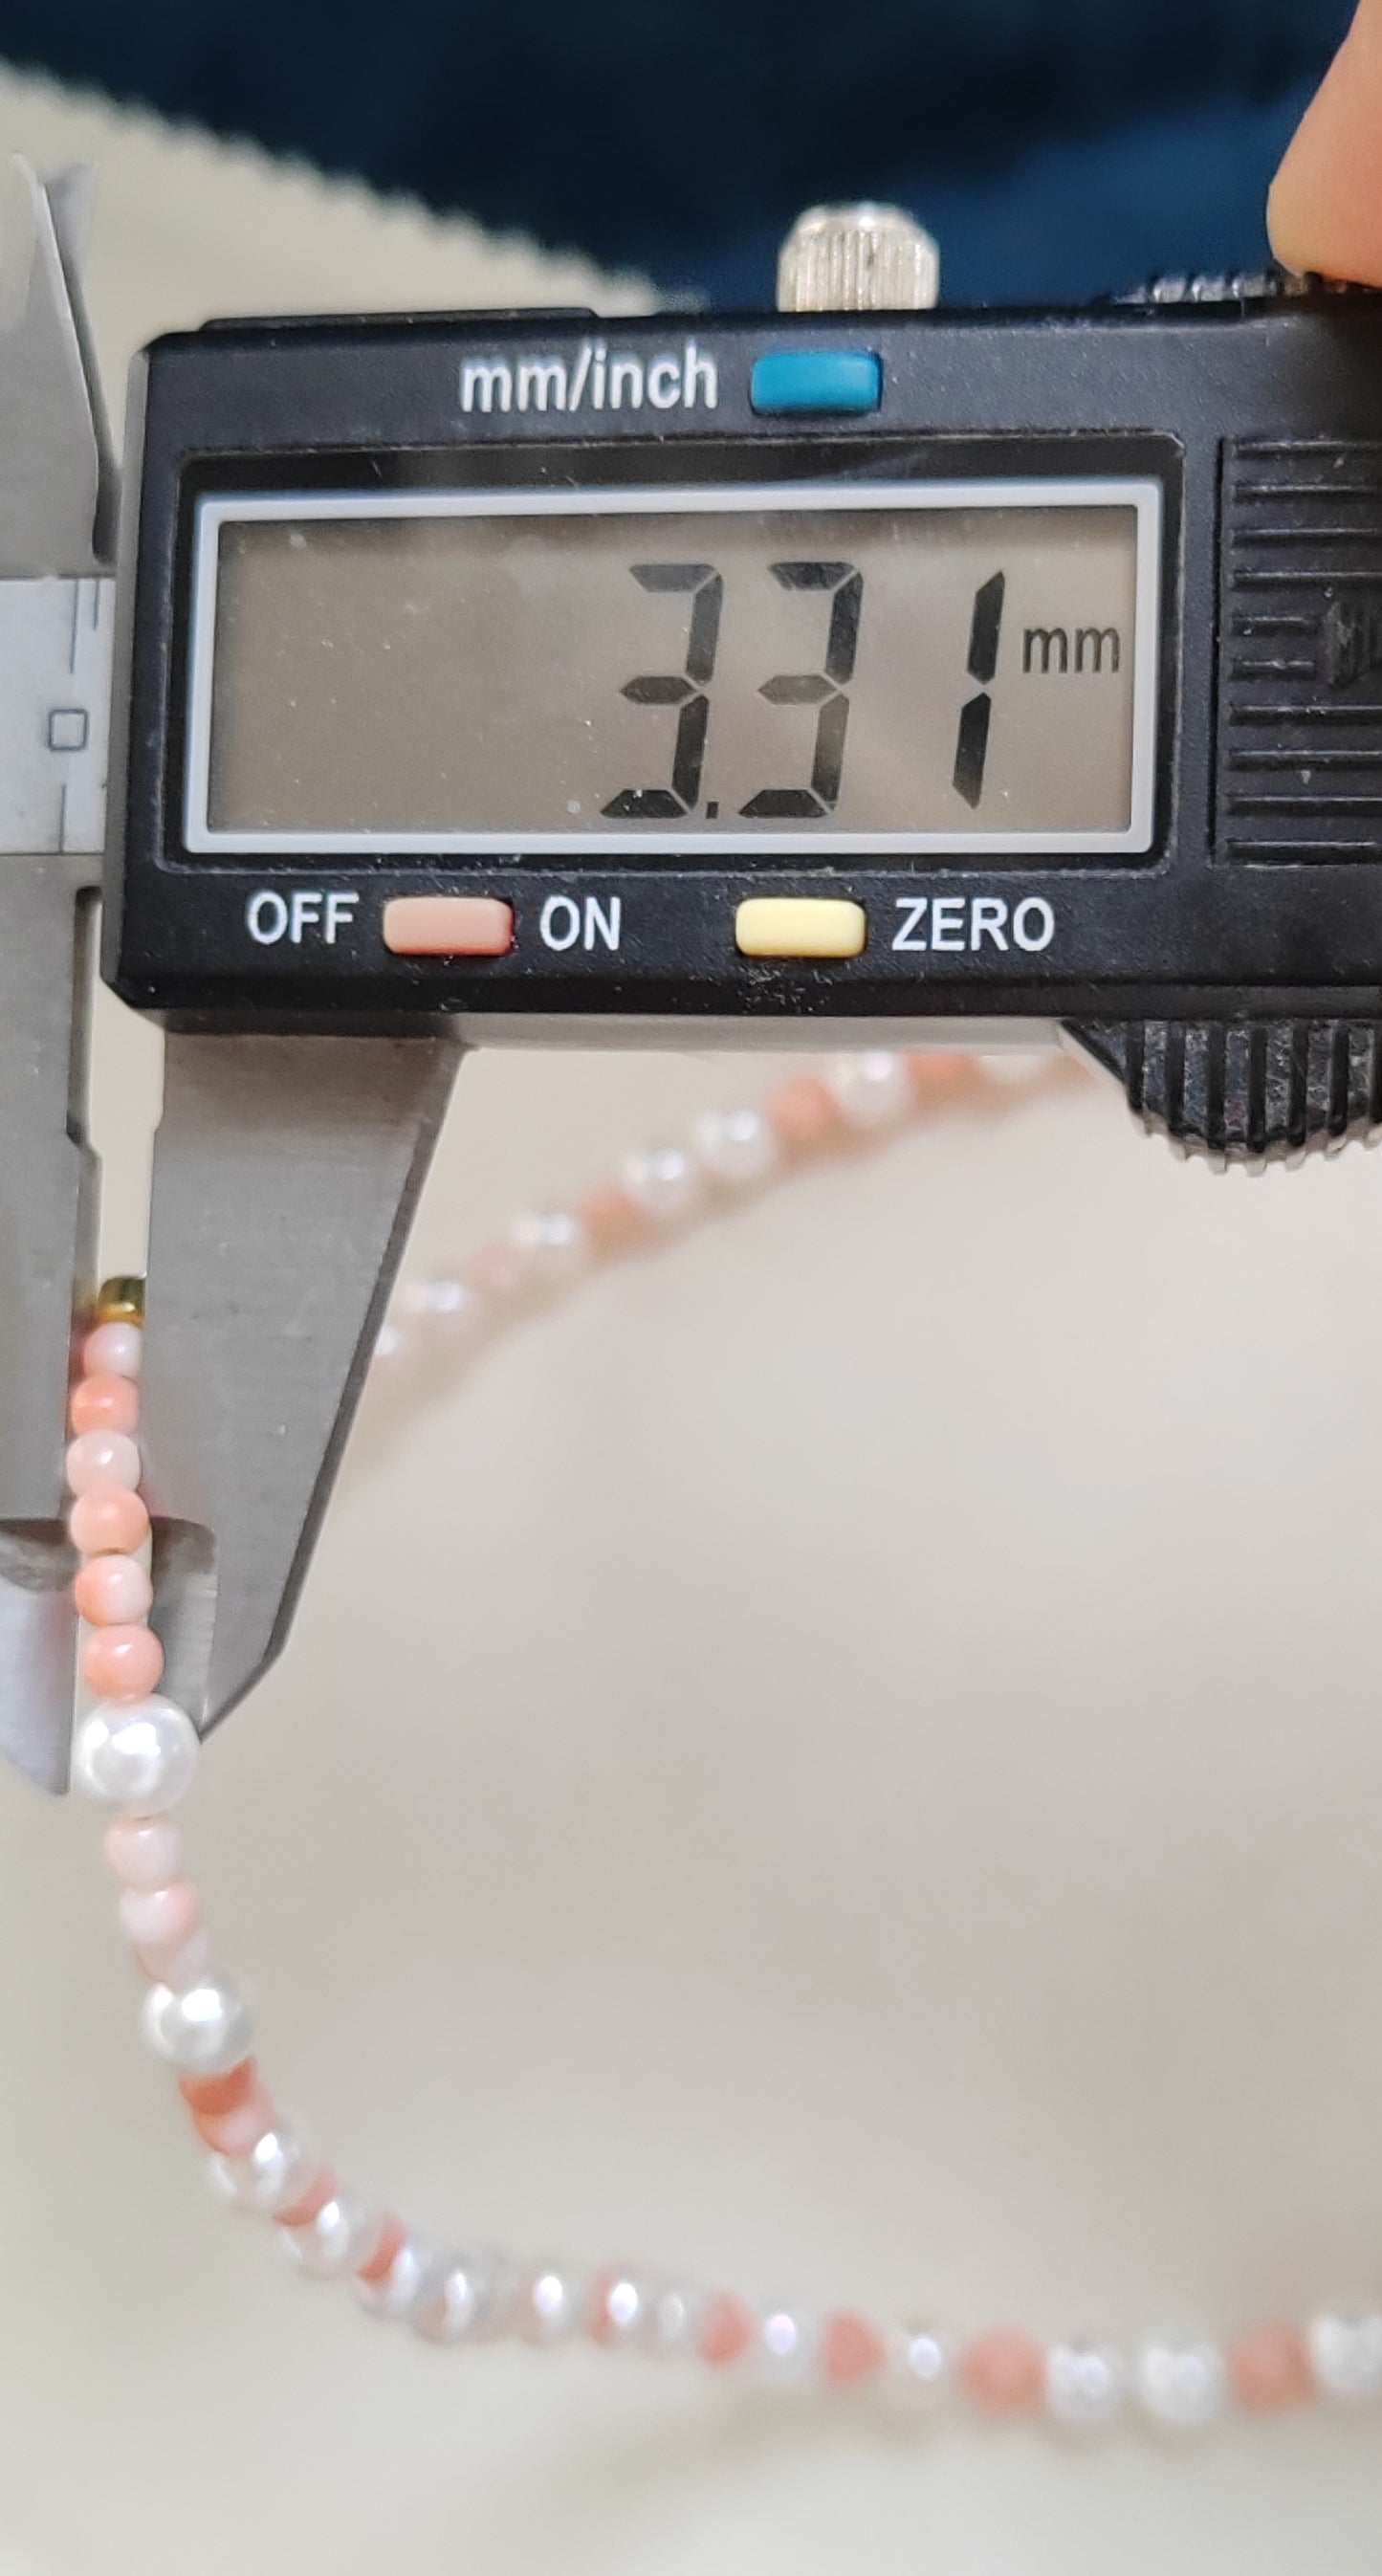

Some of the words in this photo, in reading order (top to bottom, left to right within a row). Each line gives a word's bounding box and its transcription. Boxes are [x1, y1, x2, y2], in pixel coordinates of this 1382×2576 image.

[461, 339, 719, 413] mm/inch
[601, 561, 1006, 819] 3.31
[1022, 627, 1121, 674] mm
[247, 891, 360, 945] OFF
[539, 896, 622, 951] ON
[891, 897, 1056, 952] ZERO
